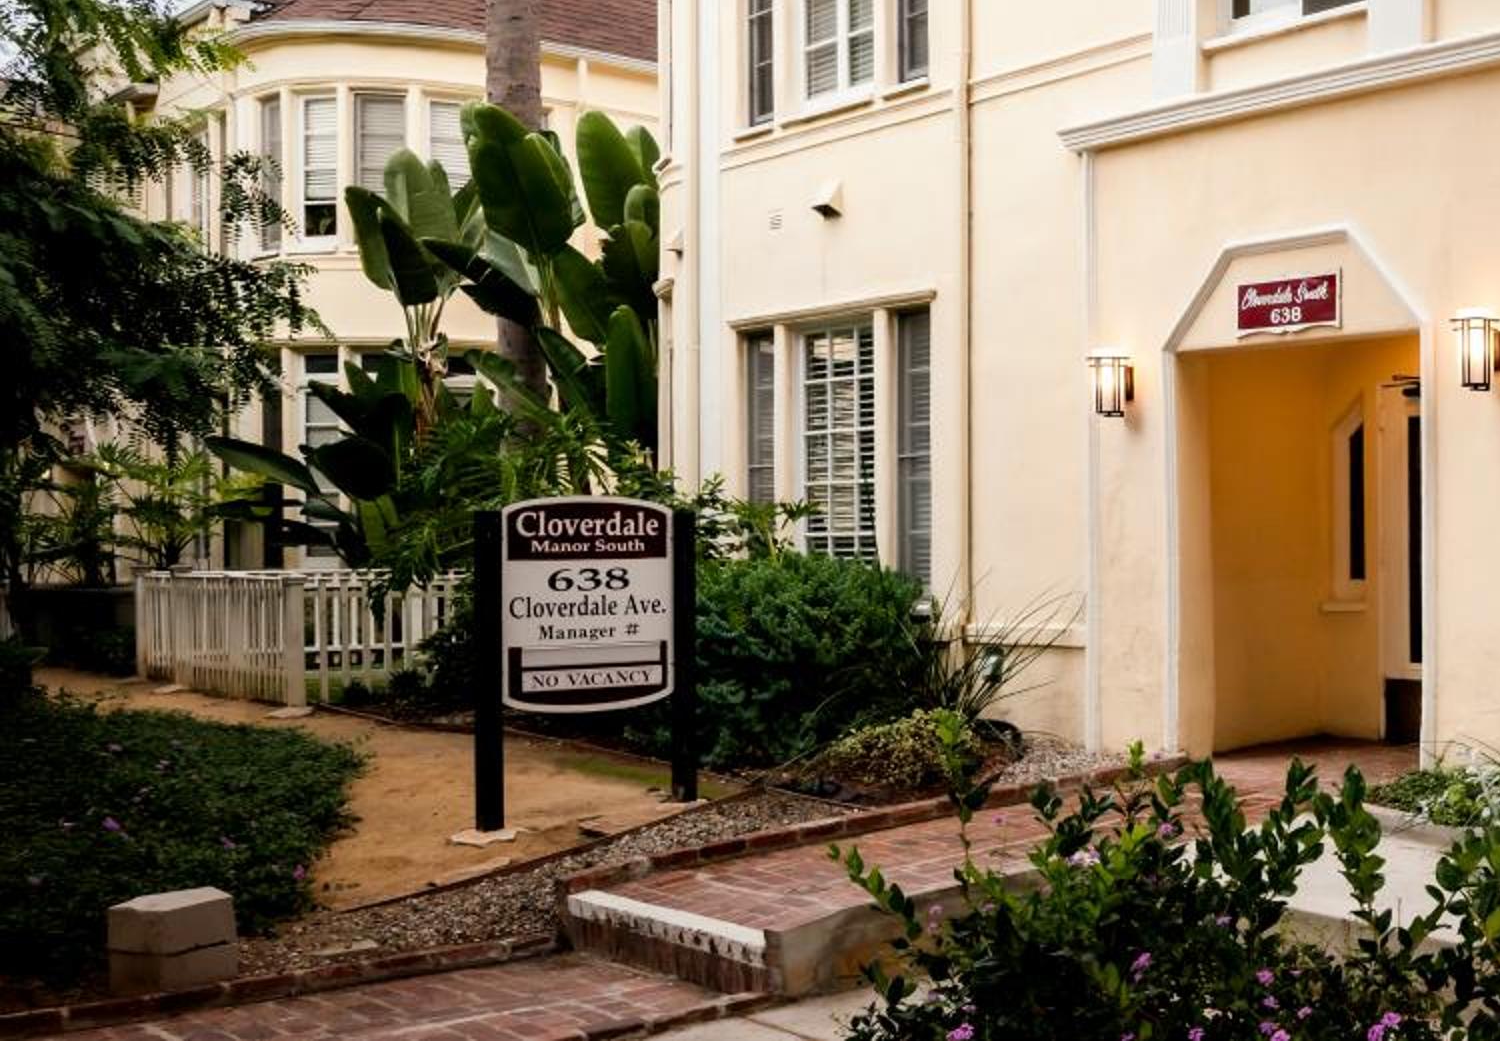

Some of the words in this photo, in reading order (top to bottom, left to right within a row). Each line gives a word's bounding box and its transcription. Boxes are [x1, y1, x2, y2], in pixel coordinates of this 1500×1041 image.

[1270, 306, 1302, 324] 638
[516, 511, 659, 537] Cloverdale
[531, 540, 590, 553] Manor
[595, 539, 645, 552] South
[548, 567, 630, 592] 638
[509, 595, 618, 619] Cloverdale
[624, 594, 667, 615] Ave.
[539, 625, 616, 640] Manager
[624, 623, 640, 636] #
[532, 674, 559, 689] NO
[568, 670, 653, 687] VACANCY
